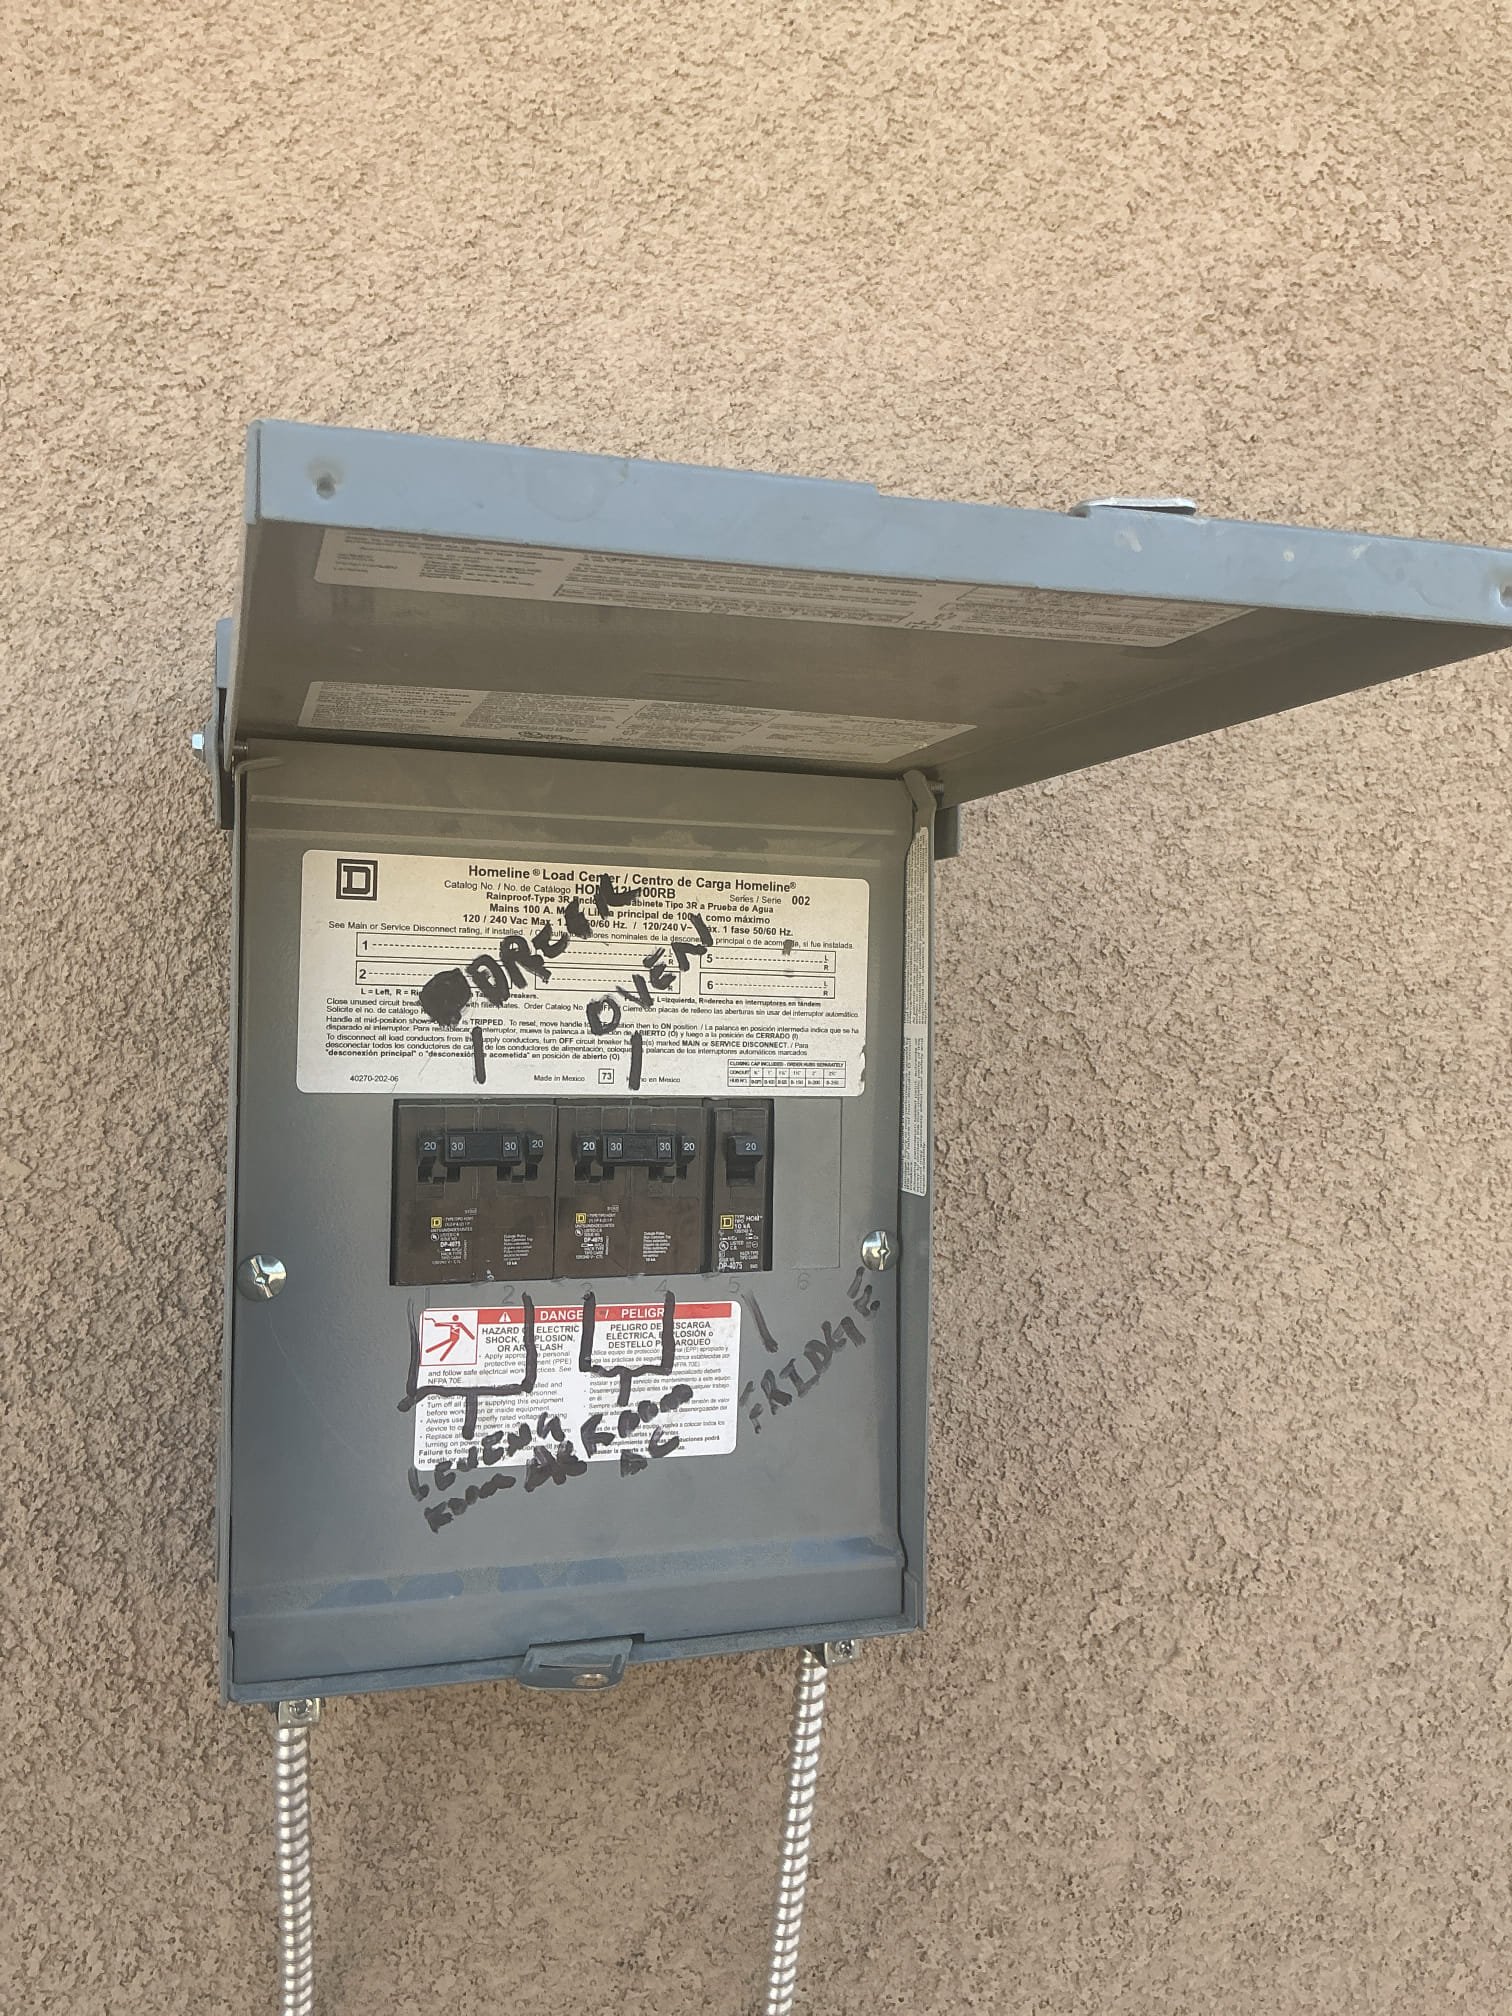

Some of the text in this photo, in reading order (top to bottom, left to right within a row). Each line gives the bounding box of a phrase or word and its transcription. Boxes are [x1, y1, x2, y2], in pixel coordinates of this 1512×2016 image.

[469, 865, 530, 878] Homeline
[543, 869, 574, 880] Load
[579, 871, 620, 884] Cener
[632, 874, 673, 886] Centro
[678, 876, 692, 887] de
[696, 878, 731, 891] Carga
[444, 880, 478, 891] Catalog
[481, 882, 494, 890] No.
[504, 883, 517, 891] No.
[521, 884, 530, 892] de
[730, 895, 753, 903] Series
[762, 896, 781, 904] Serie
[792, 896, 810, 905] 002
[486, 892, 554, 904] Rainproof-Type
[666, 901, 683, 910] Tipo
[708, 903, 737, 911] Prueba
[752, 905, 773, 914] Agua
[490, 903, 519, 913] Mains
[524, 905, 540, 913] 100
[543, 906, 553, 914] A.
[618, 910, 660, 921] principal
[662, 911, 673, 920] de
[735, 915, 770, 924] máximo
[329, 921, 344, 929] See
[381, 923, 410, 931] Service
[413, 924, 456, 932] Disconnect
[459, 927, 482, 935] rating,
[650, 933, 659, 941] de
[463, 914, 480, 922] 120
[490, 916, 507, 924] 240
[510, 916, 528, 924] Vac
[643, 922, 678, 930] 120/240
[731, 926, 750, 934] fase
[780, 928, 793, 936] Hz.
[362, 940, 368, 950] 1
[707, 954, 712, 963] 5
[359, 969, 366, 979] 2
[707, 981, 713, 990] 6
[546, 1003, 571, 1011] Catalog
[424, 1140, 756, 1151] 20 30 30 20 20 30 30 20 20
[540, 1308, 664, 1320] DANGE PELIGR
[482, 1327, 519, 1335] HAZARD
[498, 1344, 509, 1352] OR
[608, 1340, 653, 1348] DESTELLO
[426, 1417, 449, 1425] Always
